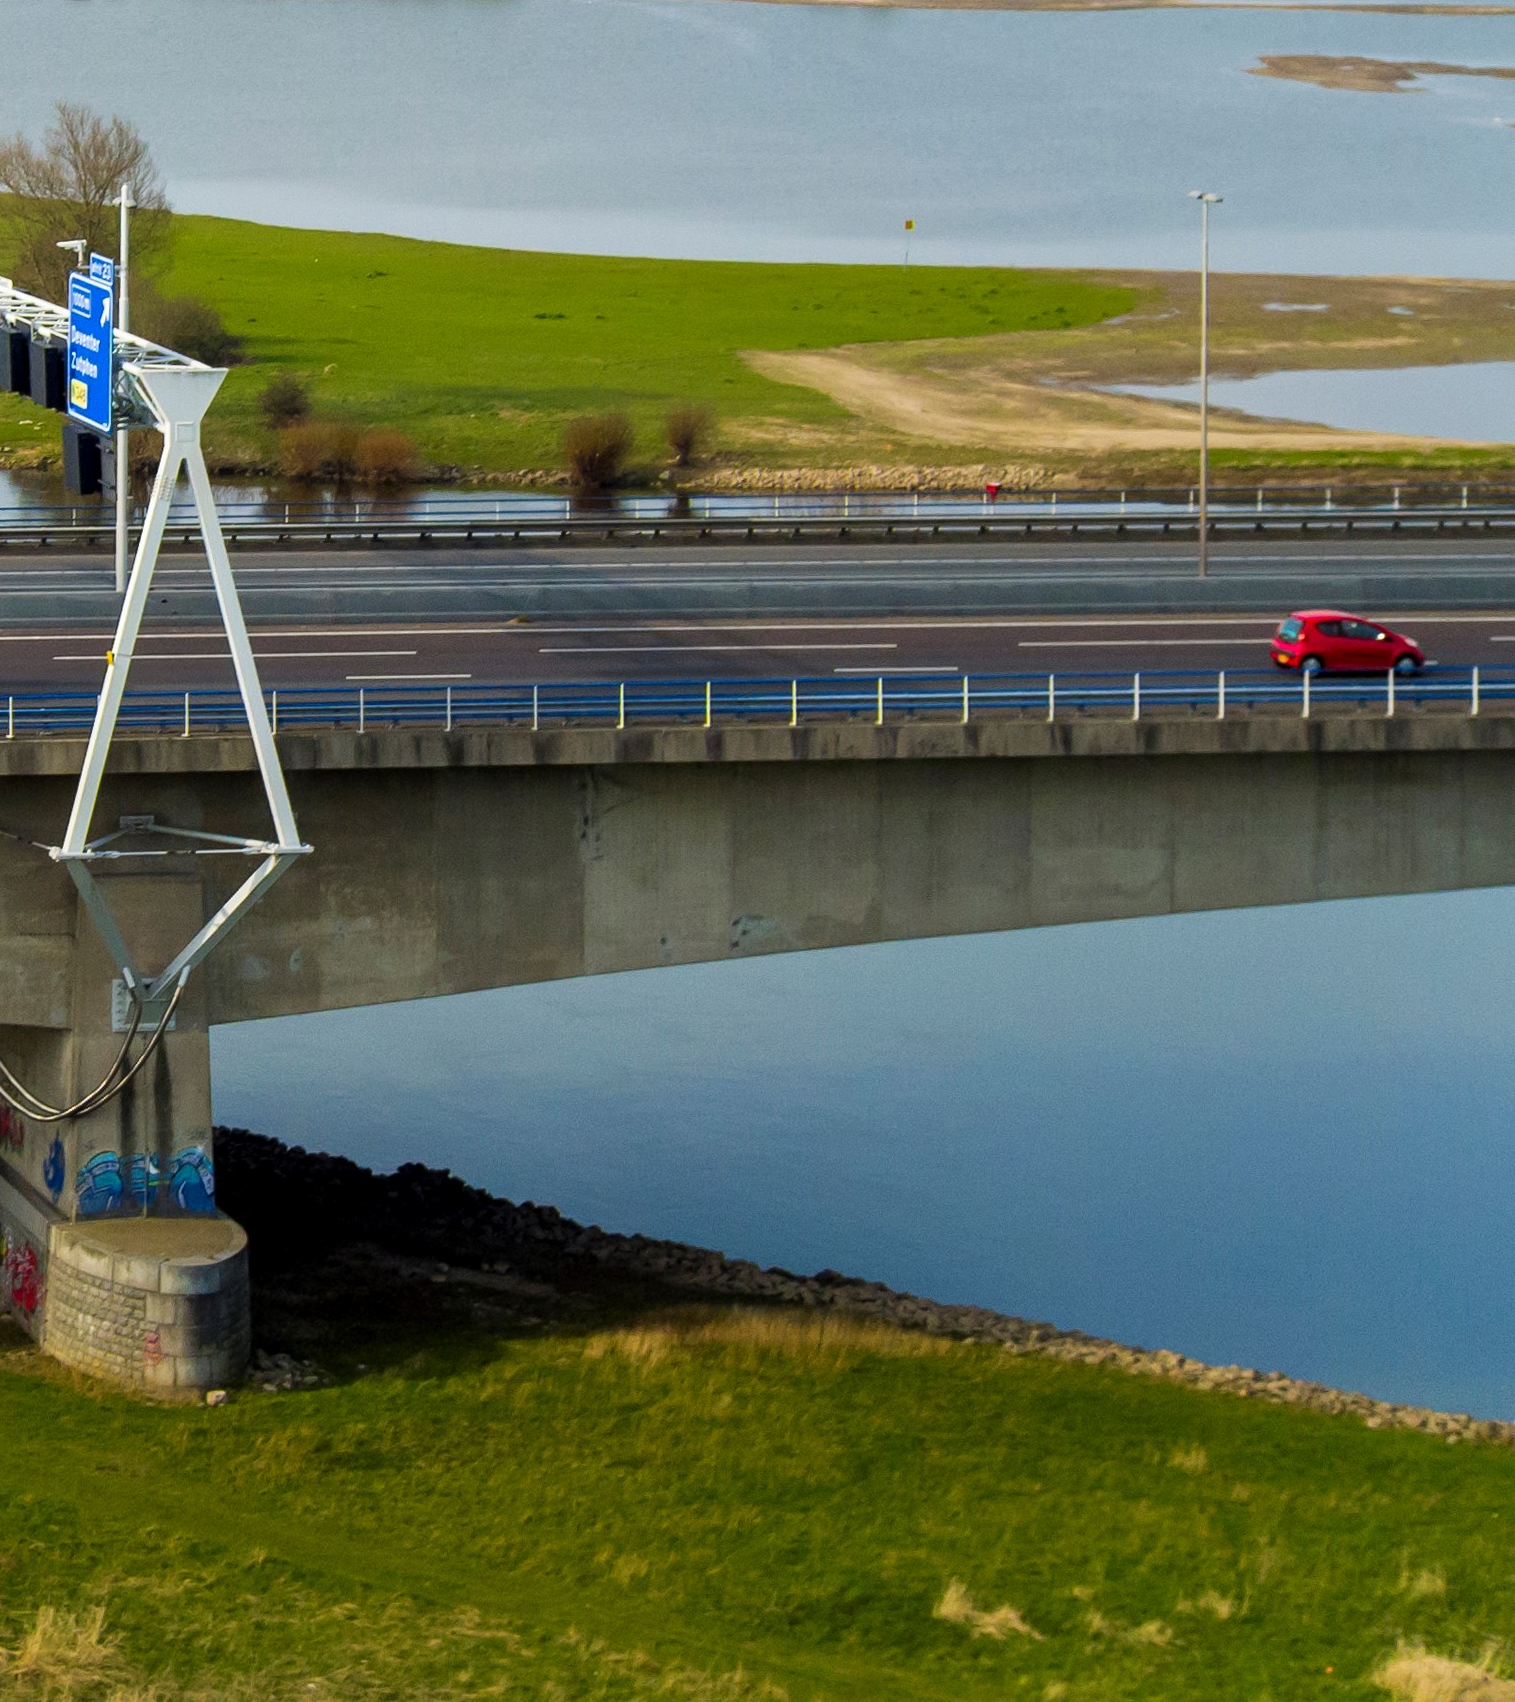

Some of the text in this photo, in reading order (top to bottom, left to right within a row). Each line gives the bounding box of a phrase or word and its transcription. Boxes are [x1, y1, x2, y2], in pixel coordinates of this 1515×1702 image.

[102, 263, 112, 280] 23
[71, 325, 100, 353] Deventer
[71, 351, 98, 378] Zutphen
